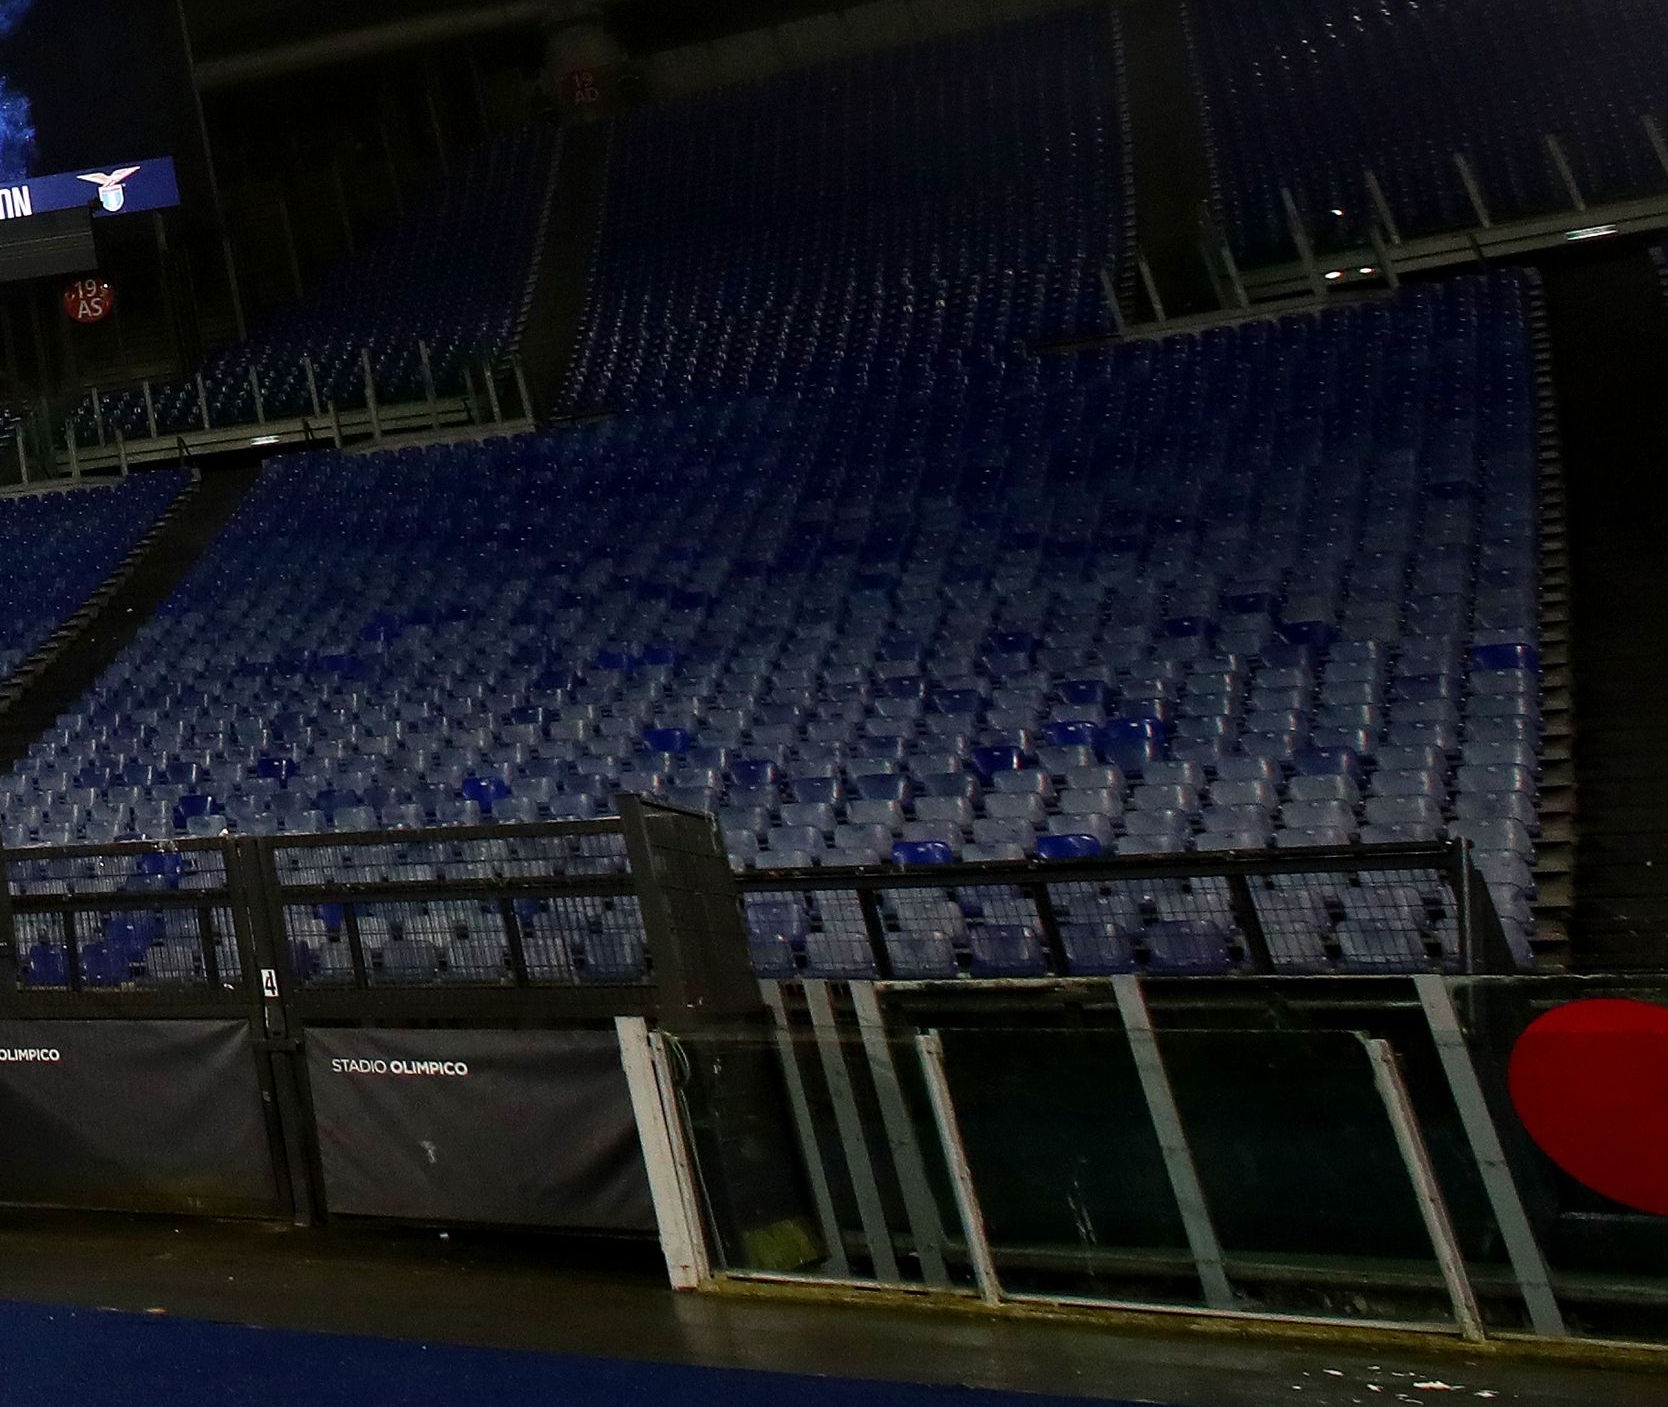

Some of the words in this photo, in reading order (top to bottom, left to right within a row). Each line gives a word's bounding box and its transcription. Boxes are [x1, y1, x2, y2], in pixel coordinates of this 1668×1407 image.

[74, 279, 98, 299] 19
[77, 297, 104, 320] AS
[265, 971, 277, 996] 4
[332, 1058, 387, 1074] STADIO
[389, 1060, 469, 1076] OLIMPICO
